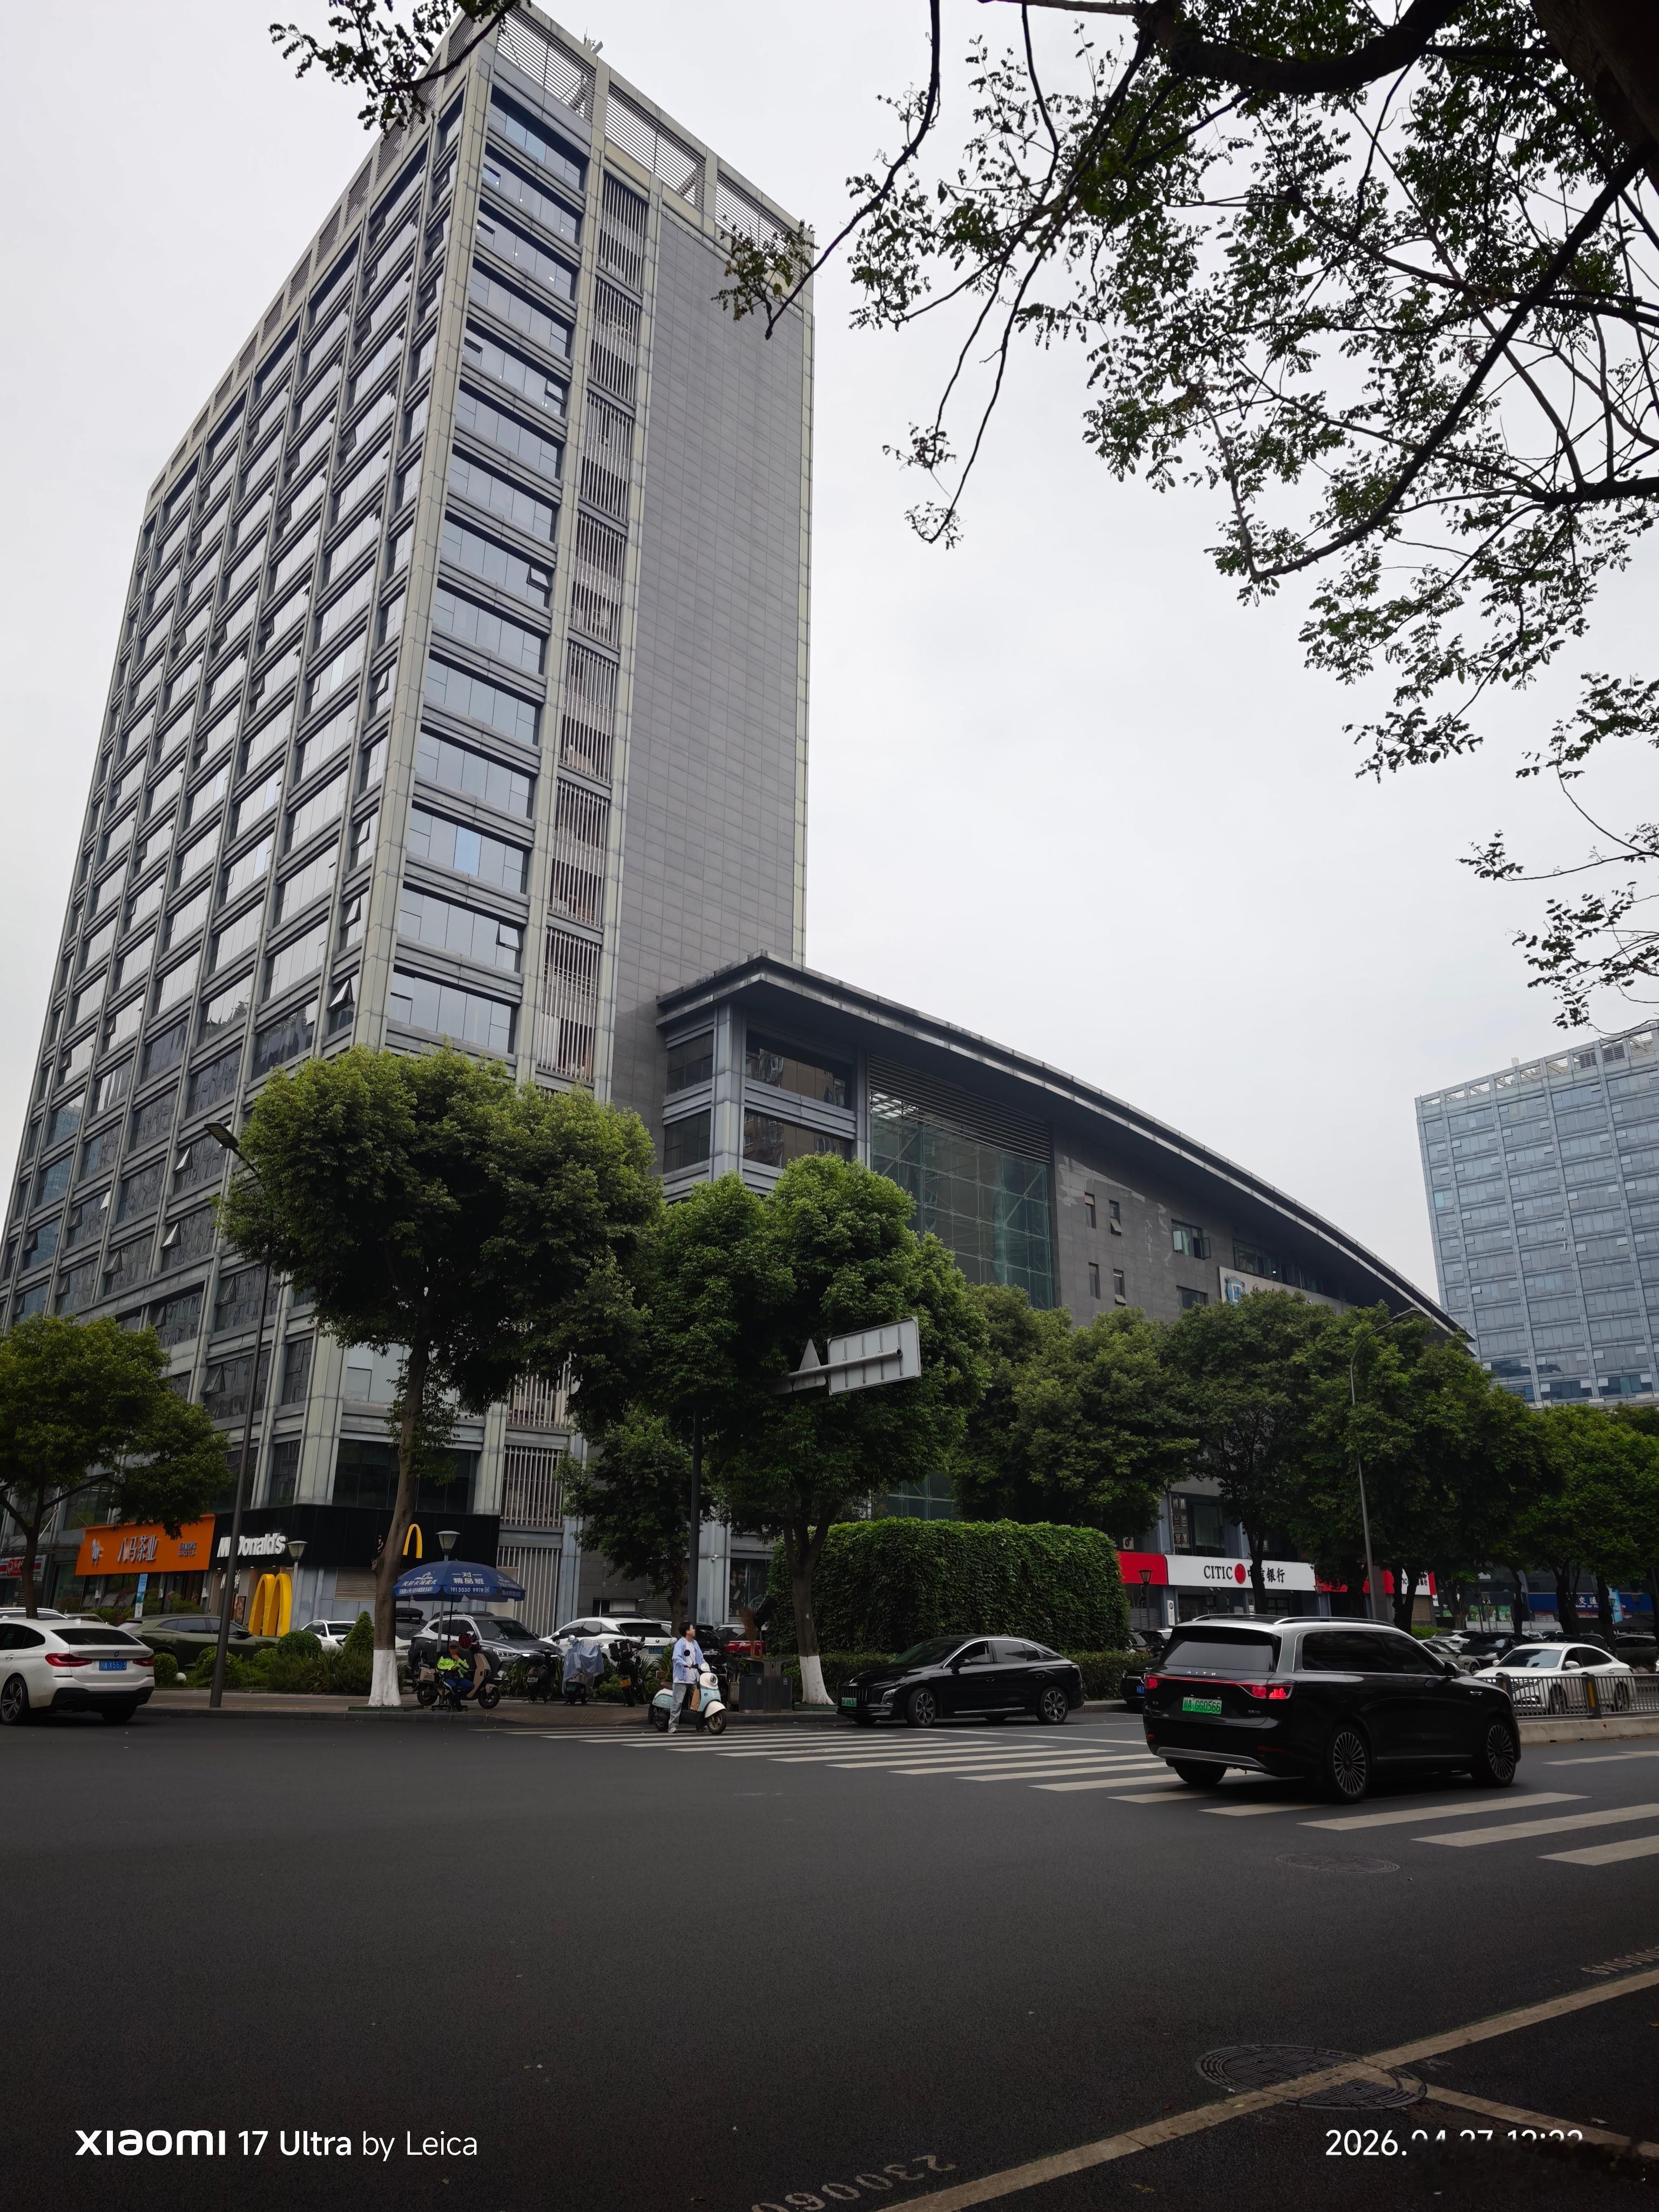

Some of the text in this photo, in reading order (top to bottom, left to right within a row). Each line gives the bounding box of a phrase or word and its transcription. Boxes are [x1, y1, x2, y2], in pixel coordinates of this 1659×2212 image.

[117, 1535, 158, 1562] 八马茶业
[217, 1533, 286, 1557] MDonald's
[1204, 1565, 1233, 1580] CITIC
